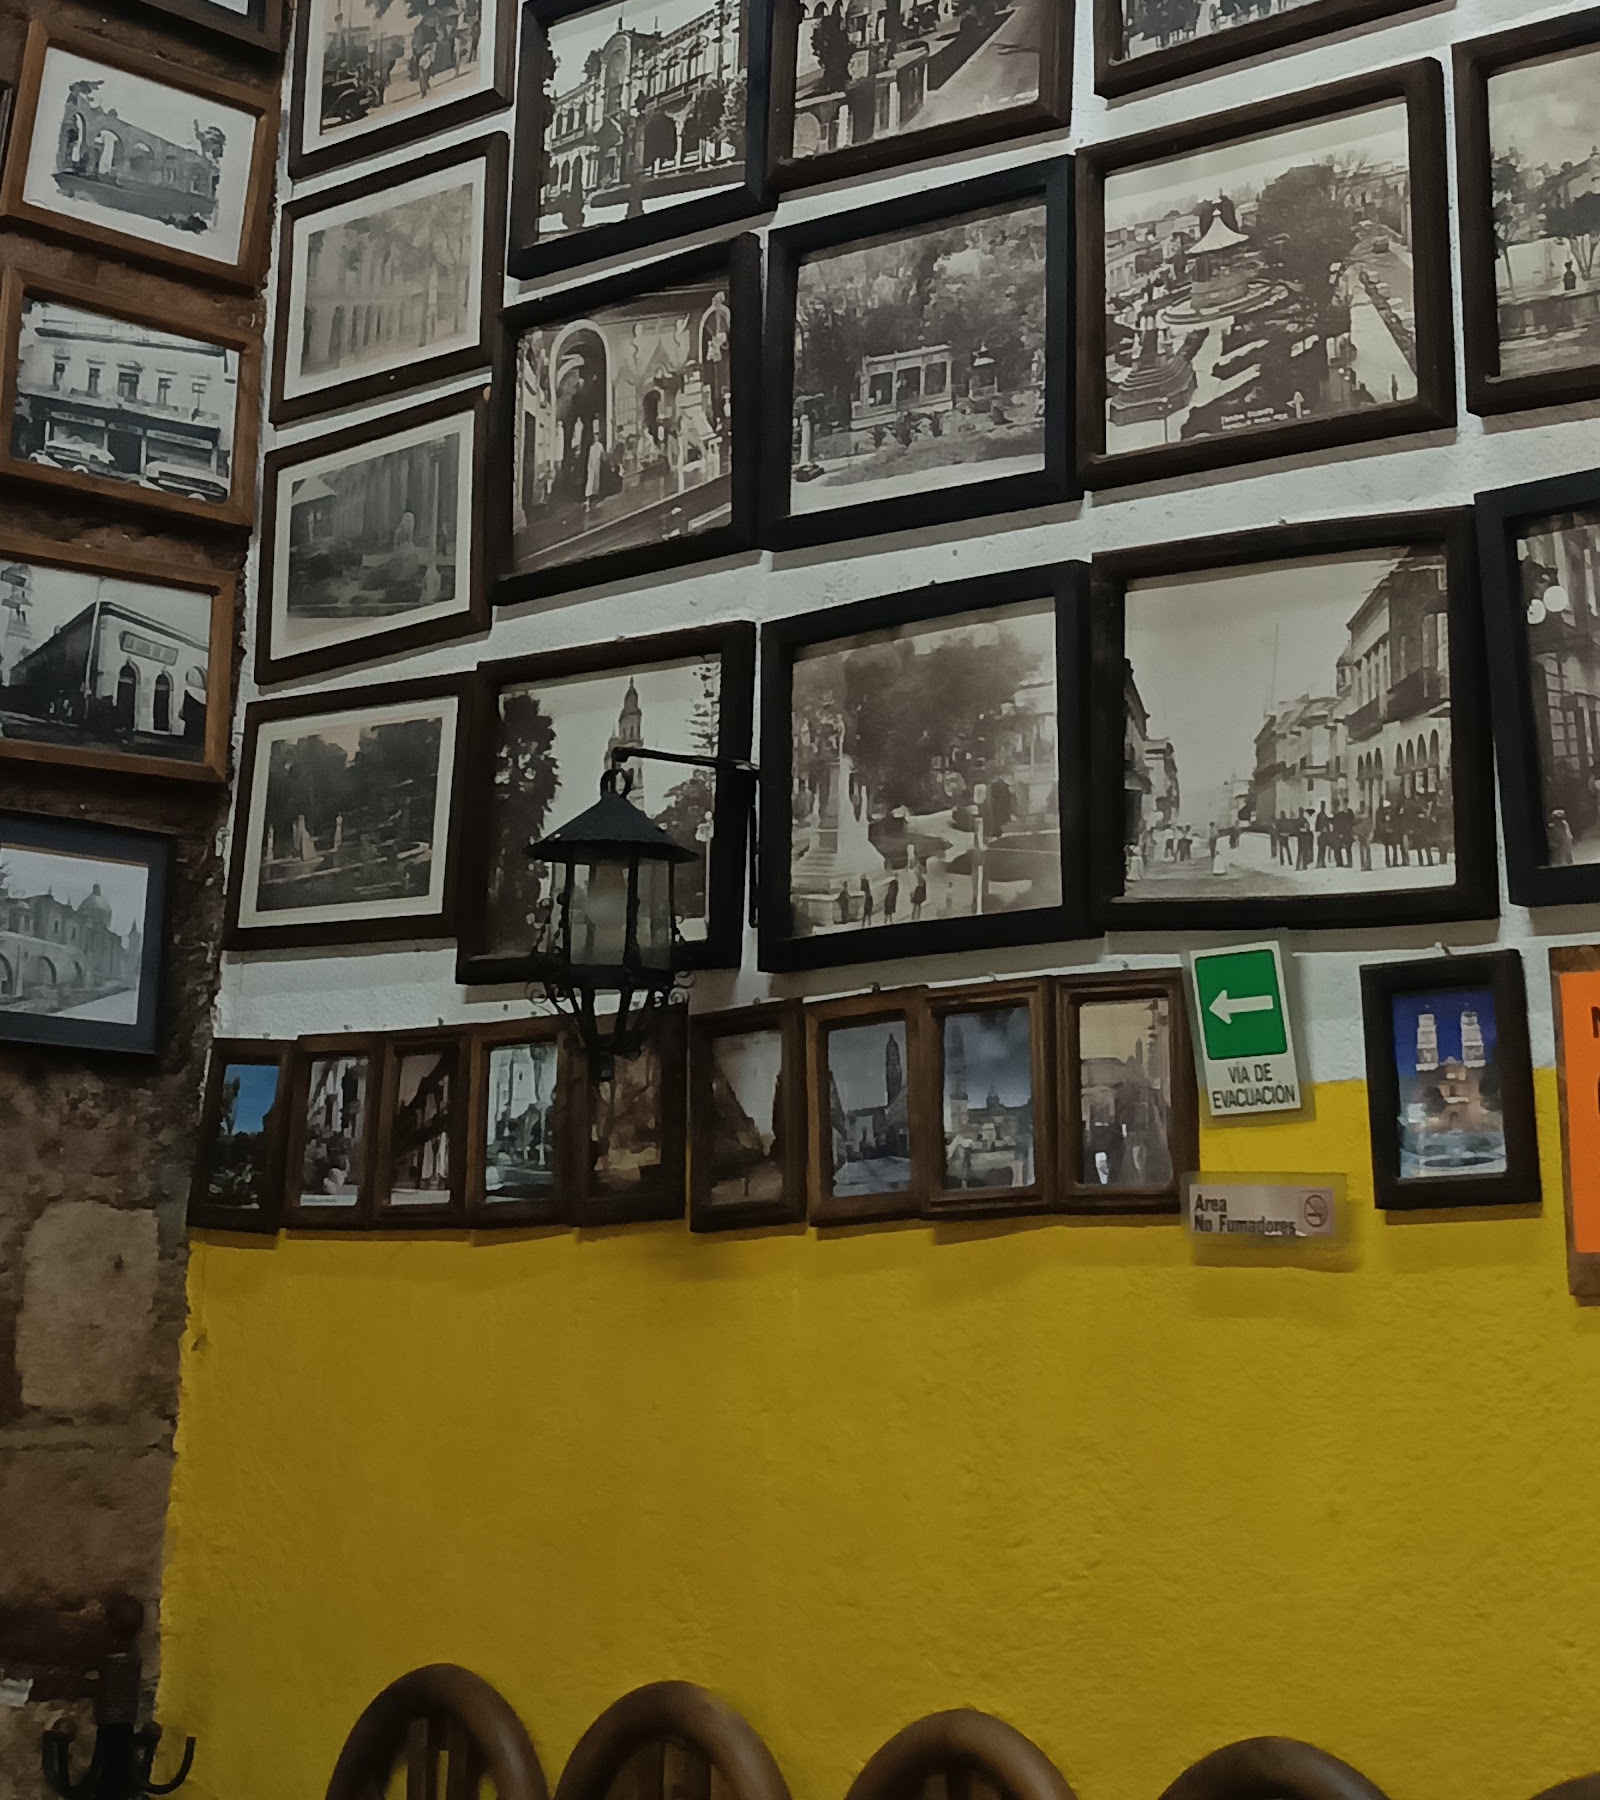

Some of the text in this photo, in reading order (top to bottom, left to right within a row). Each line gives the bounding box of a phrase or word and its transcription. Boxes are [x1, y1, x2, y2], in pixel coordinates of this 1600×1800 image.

[1254, 1063, 1273, 1082] DE
[1212, 1080, 1296, 1109] EVACUACIÓN
[1194, 1215, 1297, 1236] No Fumadores
